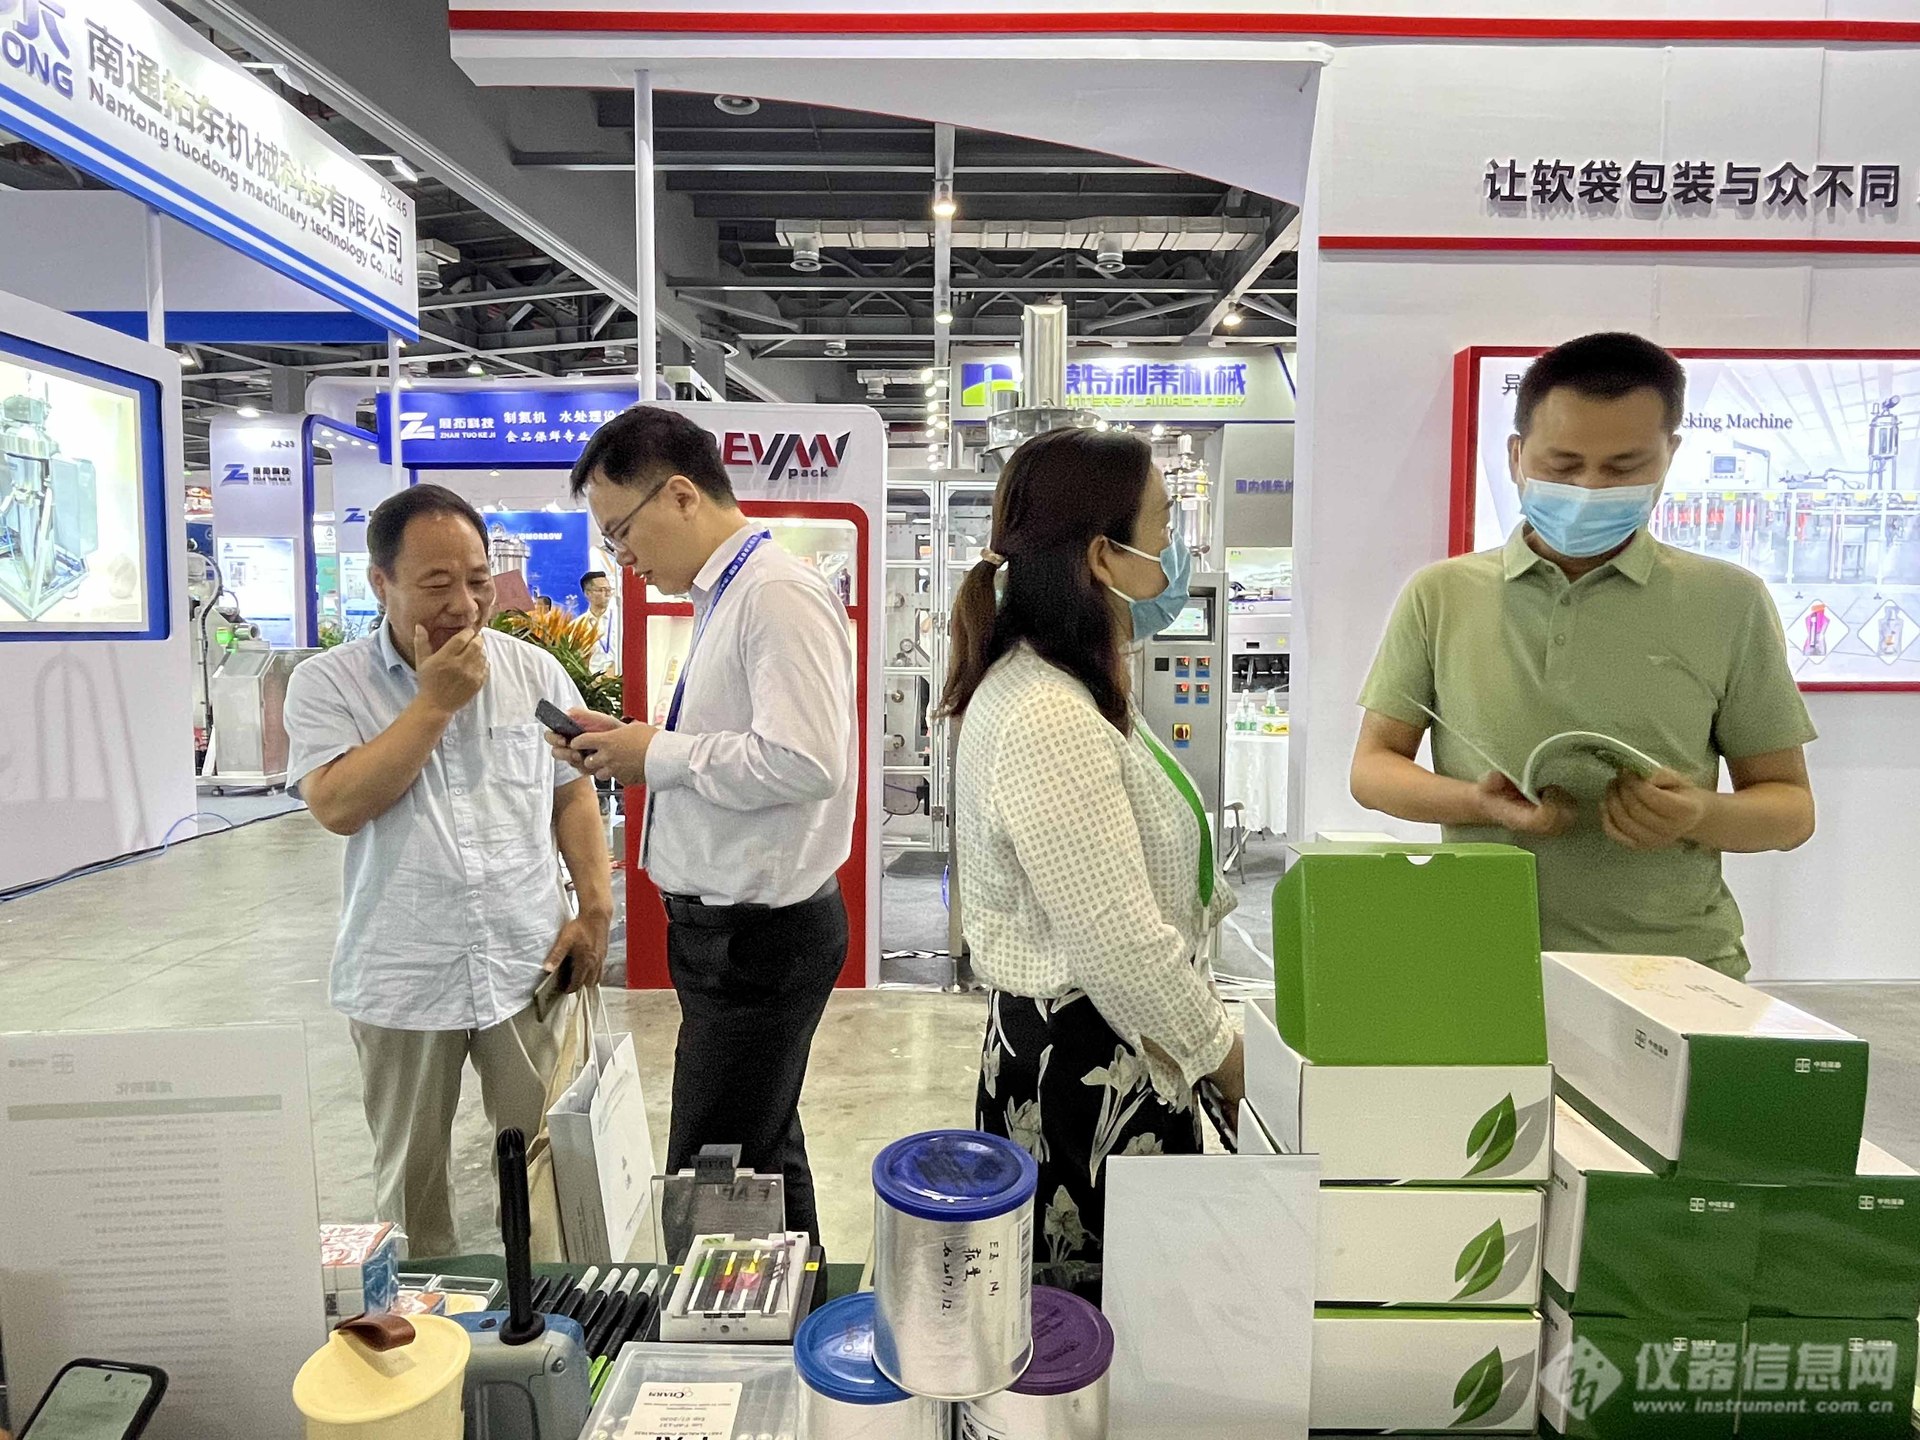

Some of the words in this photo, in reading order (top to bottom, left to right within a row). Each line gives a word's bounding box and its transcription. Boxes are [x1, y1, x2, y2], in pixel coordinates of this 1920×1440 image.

[88, 77, 169, 150] Nantong
[174, 131, 239, 192] tuodong
[243, 176, 307, 229] machinery
[310, 216, 367, 268] technology
[1486, 158, 1900, 209] 让软袋包装与众不同
[1727, 413, 1793, 430] Machine
[788, 467, 829, 480] pack
